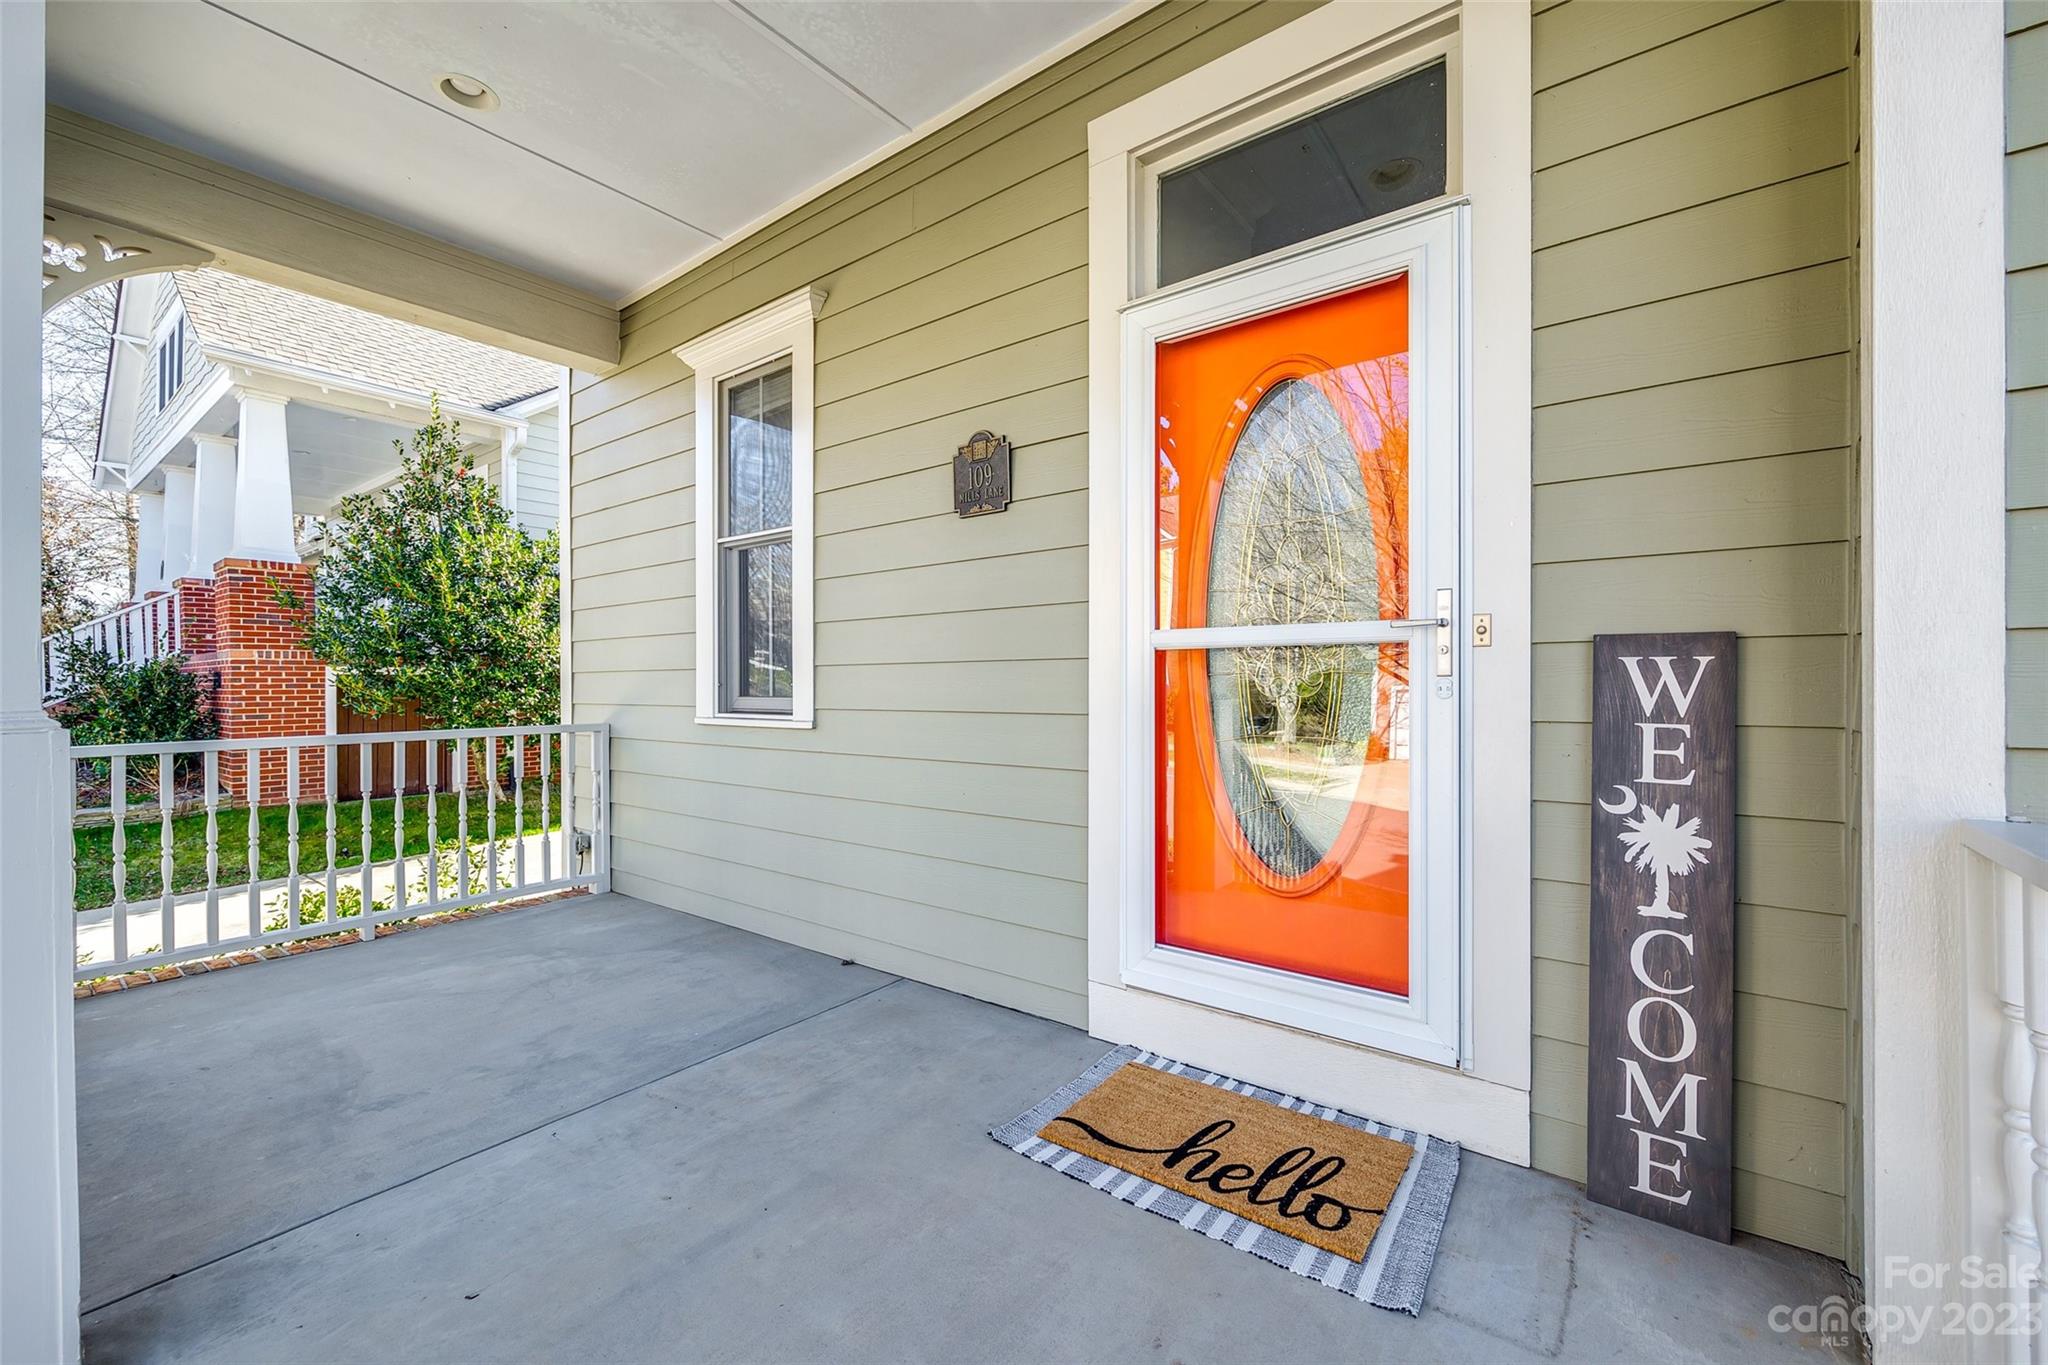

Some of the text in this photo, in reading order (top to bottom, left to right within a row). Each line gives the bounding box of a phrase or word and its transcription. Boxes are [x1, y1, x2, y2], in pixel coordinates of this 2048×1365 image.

[968, 463, 992, 490] 109
[984, 485, 1004, 499] LANE
[1053, 1119, 1384, 1231] hello
